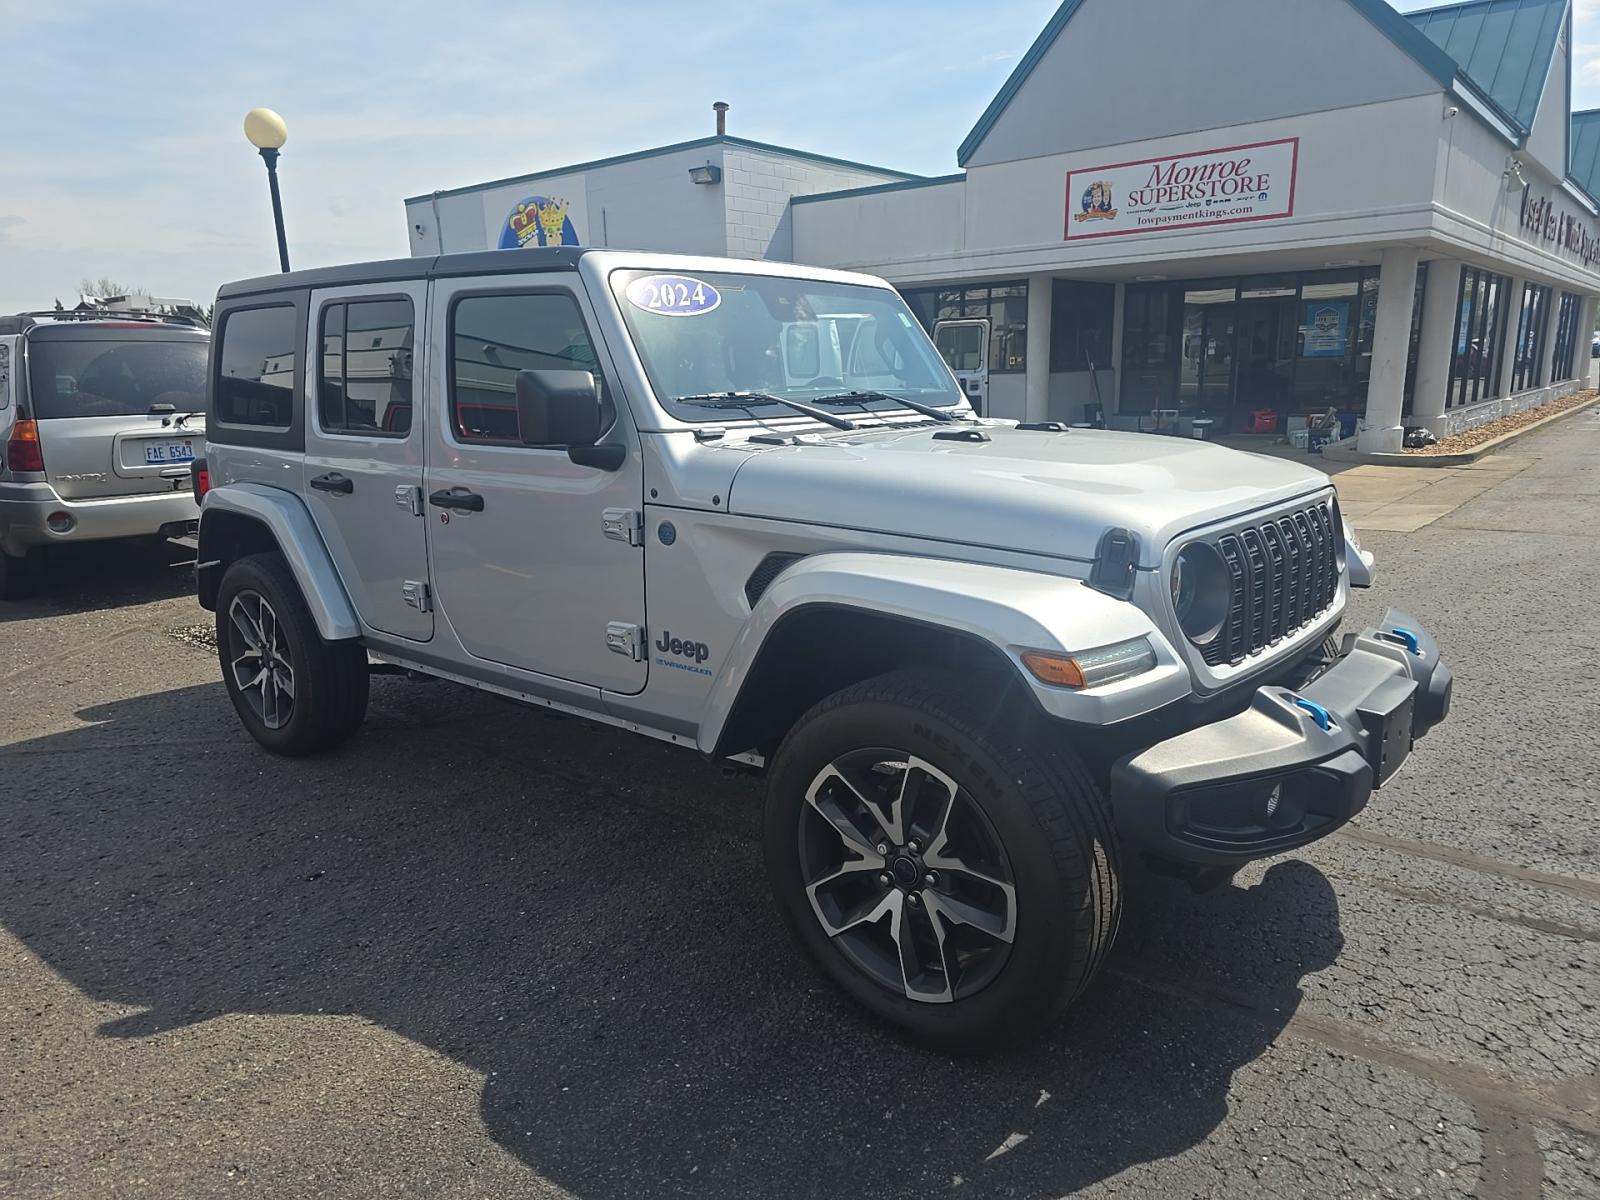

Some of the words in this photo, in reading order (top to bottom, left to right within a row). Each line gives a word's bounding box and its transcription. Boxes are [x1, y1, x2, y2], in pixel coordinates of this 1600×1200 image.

[1144, 158, 1252, 188] Monroe
[1127, 173, 1271, 208] SUPERSTORE
[1137, 206, 1253, 226] lowpaymentkings.com
[645, 282, 705, 308] 2024
[655, 630, 709, 664] Jeep
[663, 660, 712, 676] WRANGLER
